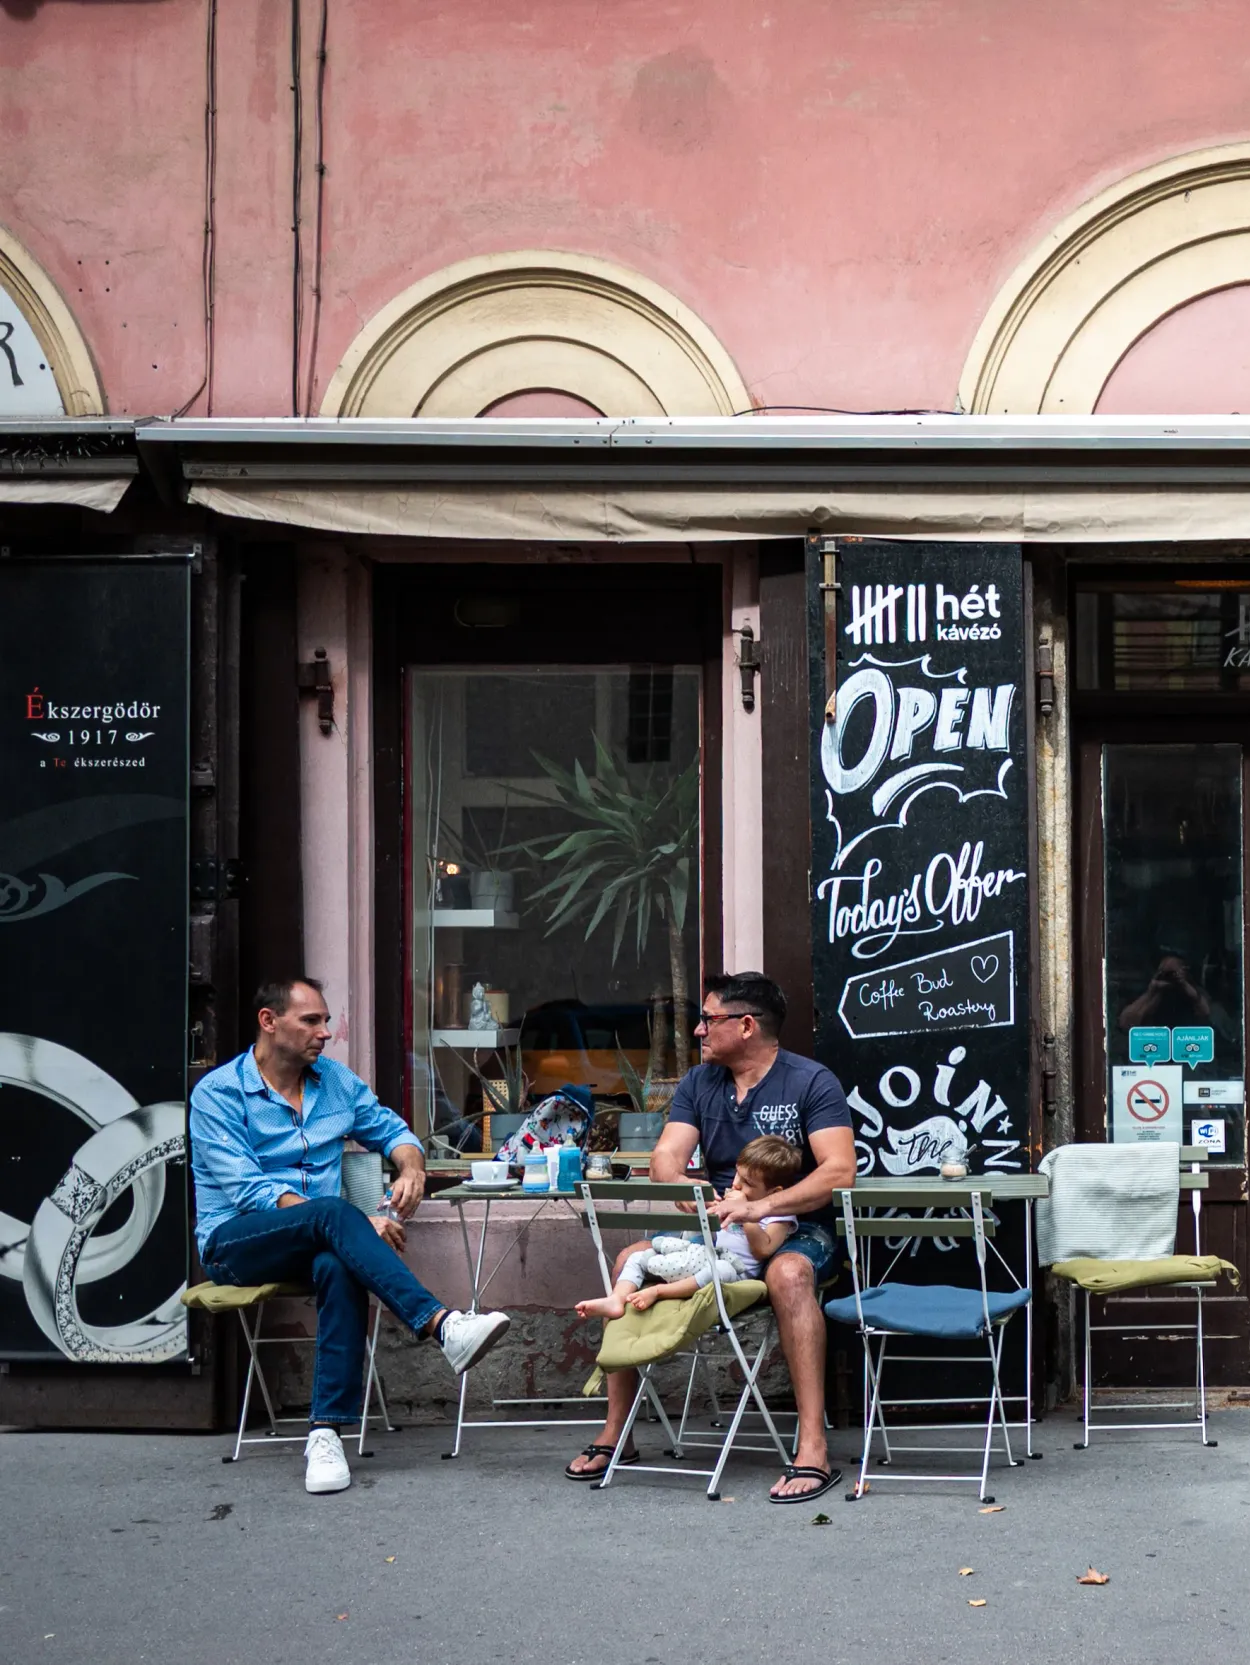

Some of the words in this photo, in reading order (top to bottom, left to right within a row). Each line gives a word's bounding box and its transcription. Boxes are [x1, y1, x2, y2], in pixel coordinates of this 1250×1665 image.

[935, 583, 1001, 621] hét
[936, 623, 1002, 641] kávézó
[25, 687, 161, 723] Ékszergödör
[68, 730, 118, 745] 1917
[821, 668, 1016, 794] OPEN
[39, 760, 46, 768] a
[53, 757, 66, 767] Te
[74, 757, 146, 767] ékszerészed
[817, 858, 943, 959] Today's
[925, 840, 1027, 926] Offer
[859, 980, 905, 1010] Coffee
[910, 969, 953, 994] Bud
[919, 999, 996, 1021] Roastery
[760, 1103, 798, 1121] GUESS
